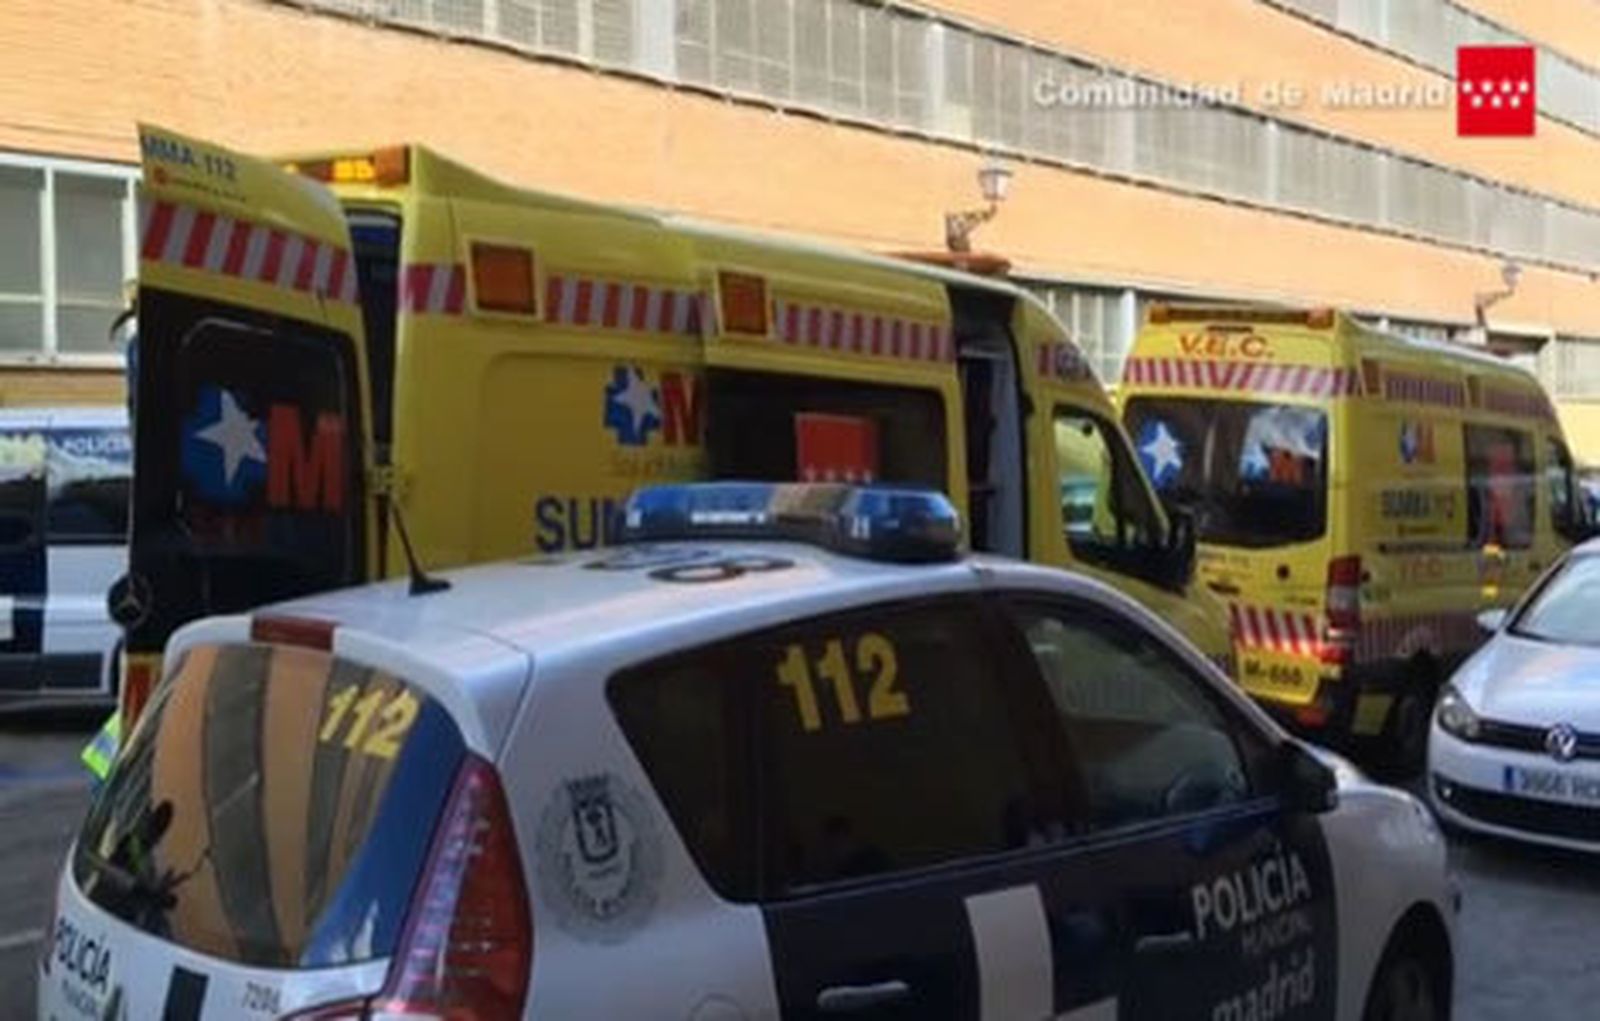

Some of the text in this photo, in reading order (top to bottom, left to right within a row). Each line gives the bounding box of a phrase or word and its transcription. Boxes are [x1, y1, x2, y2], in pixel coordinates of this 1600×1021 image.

[204, 153, 237, 183] 112
[266, 402, 345, 515] M
[320, 684, 419, 758] 112
[776, 631, 911, 732] 112
[1191, 840, 1312, 941] POLICÍA
